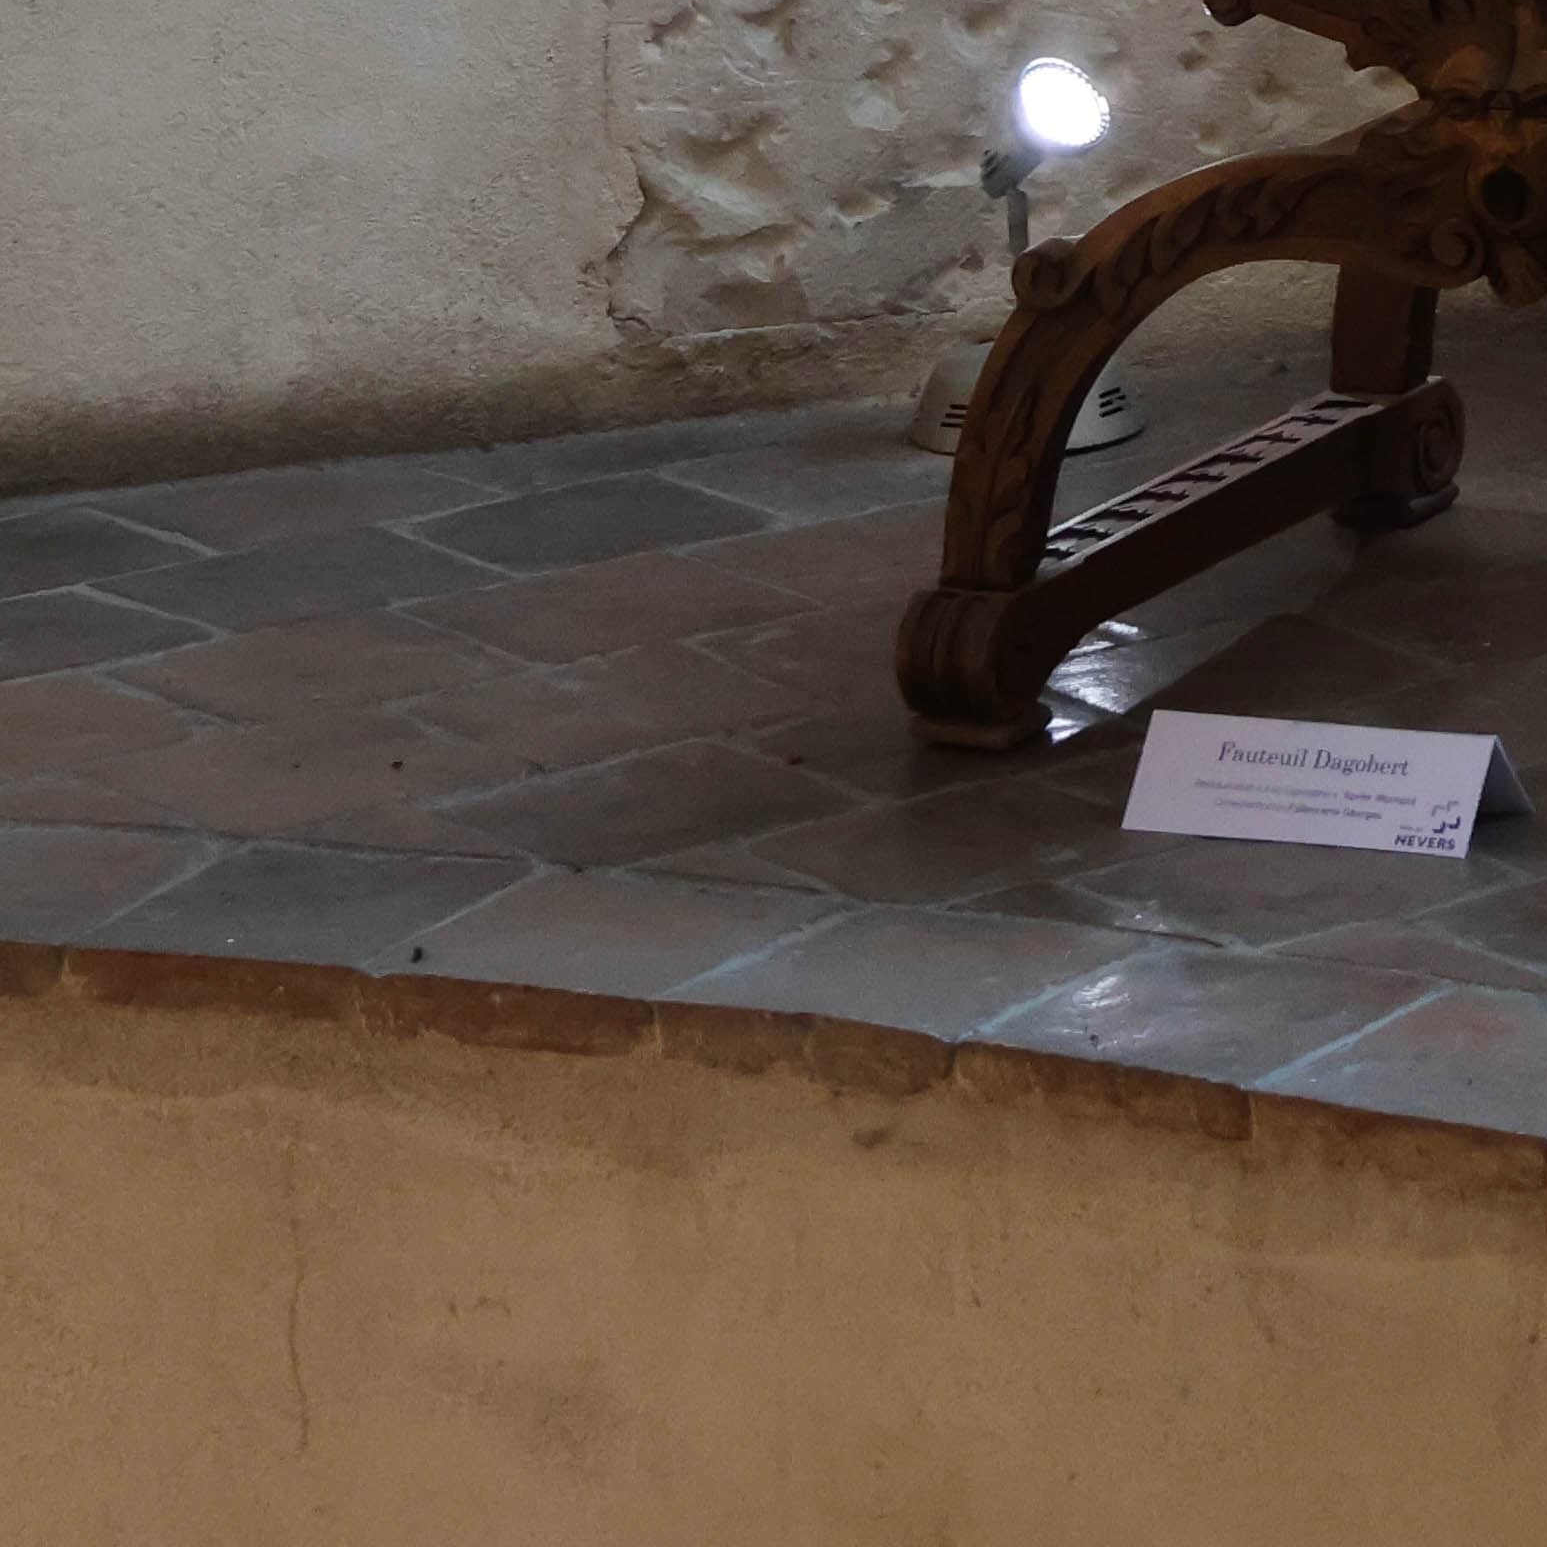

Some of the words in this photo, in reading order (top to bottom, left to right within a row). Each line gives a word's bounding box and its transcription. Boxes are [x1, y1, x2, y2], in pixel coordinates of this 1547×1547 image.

[1217, 741, 1309, 769] Fauteuil
[1313, 749, 1410, 777] Dagobert
[1394, 834, 1457, 851] NEVERS
